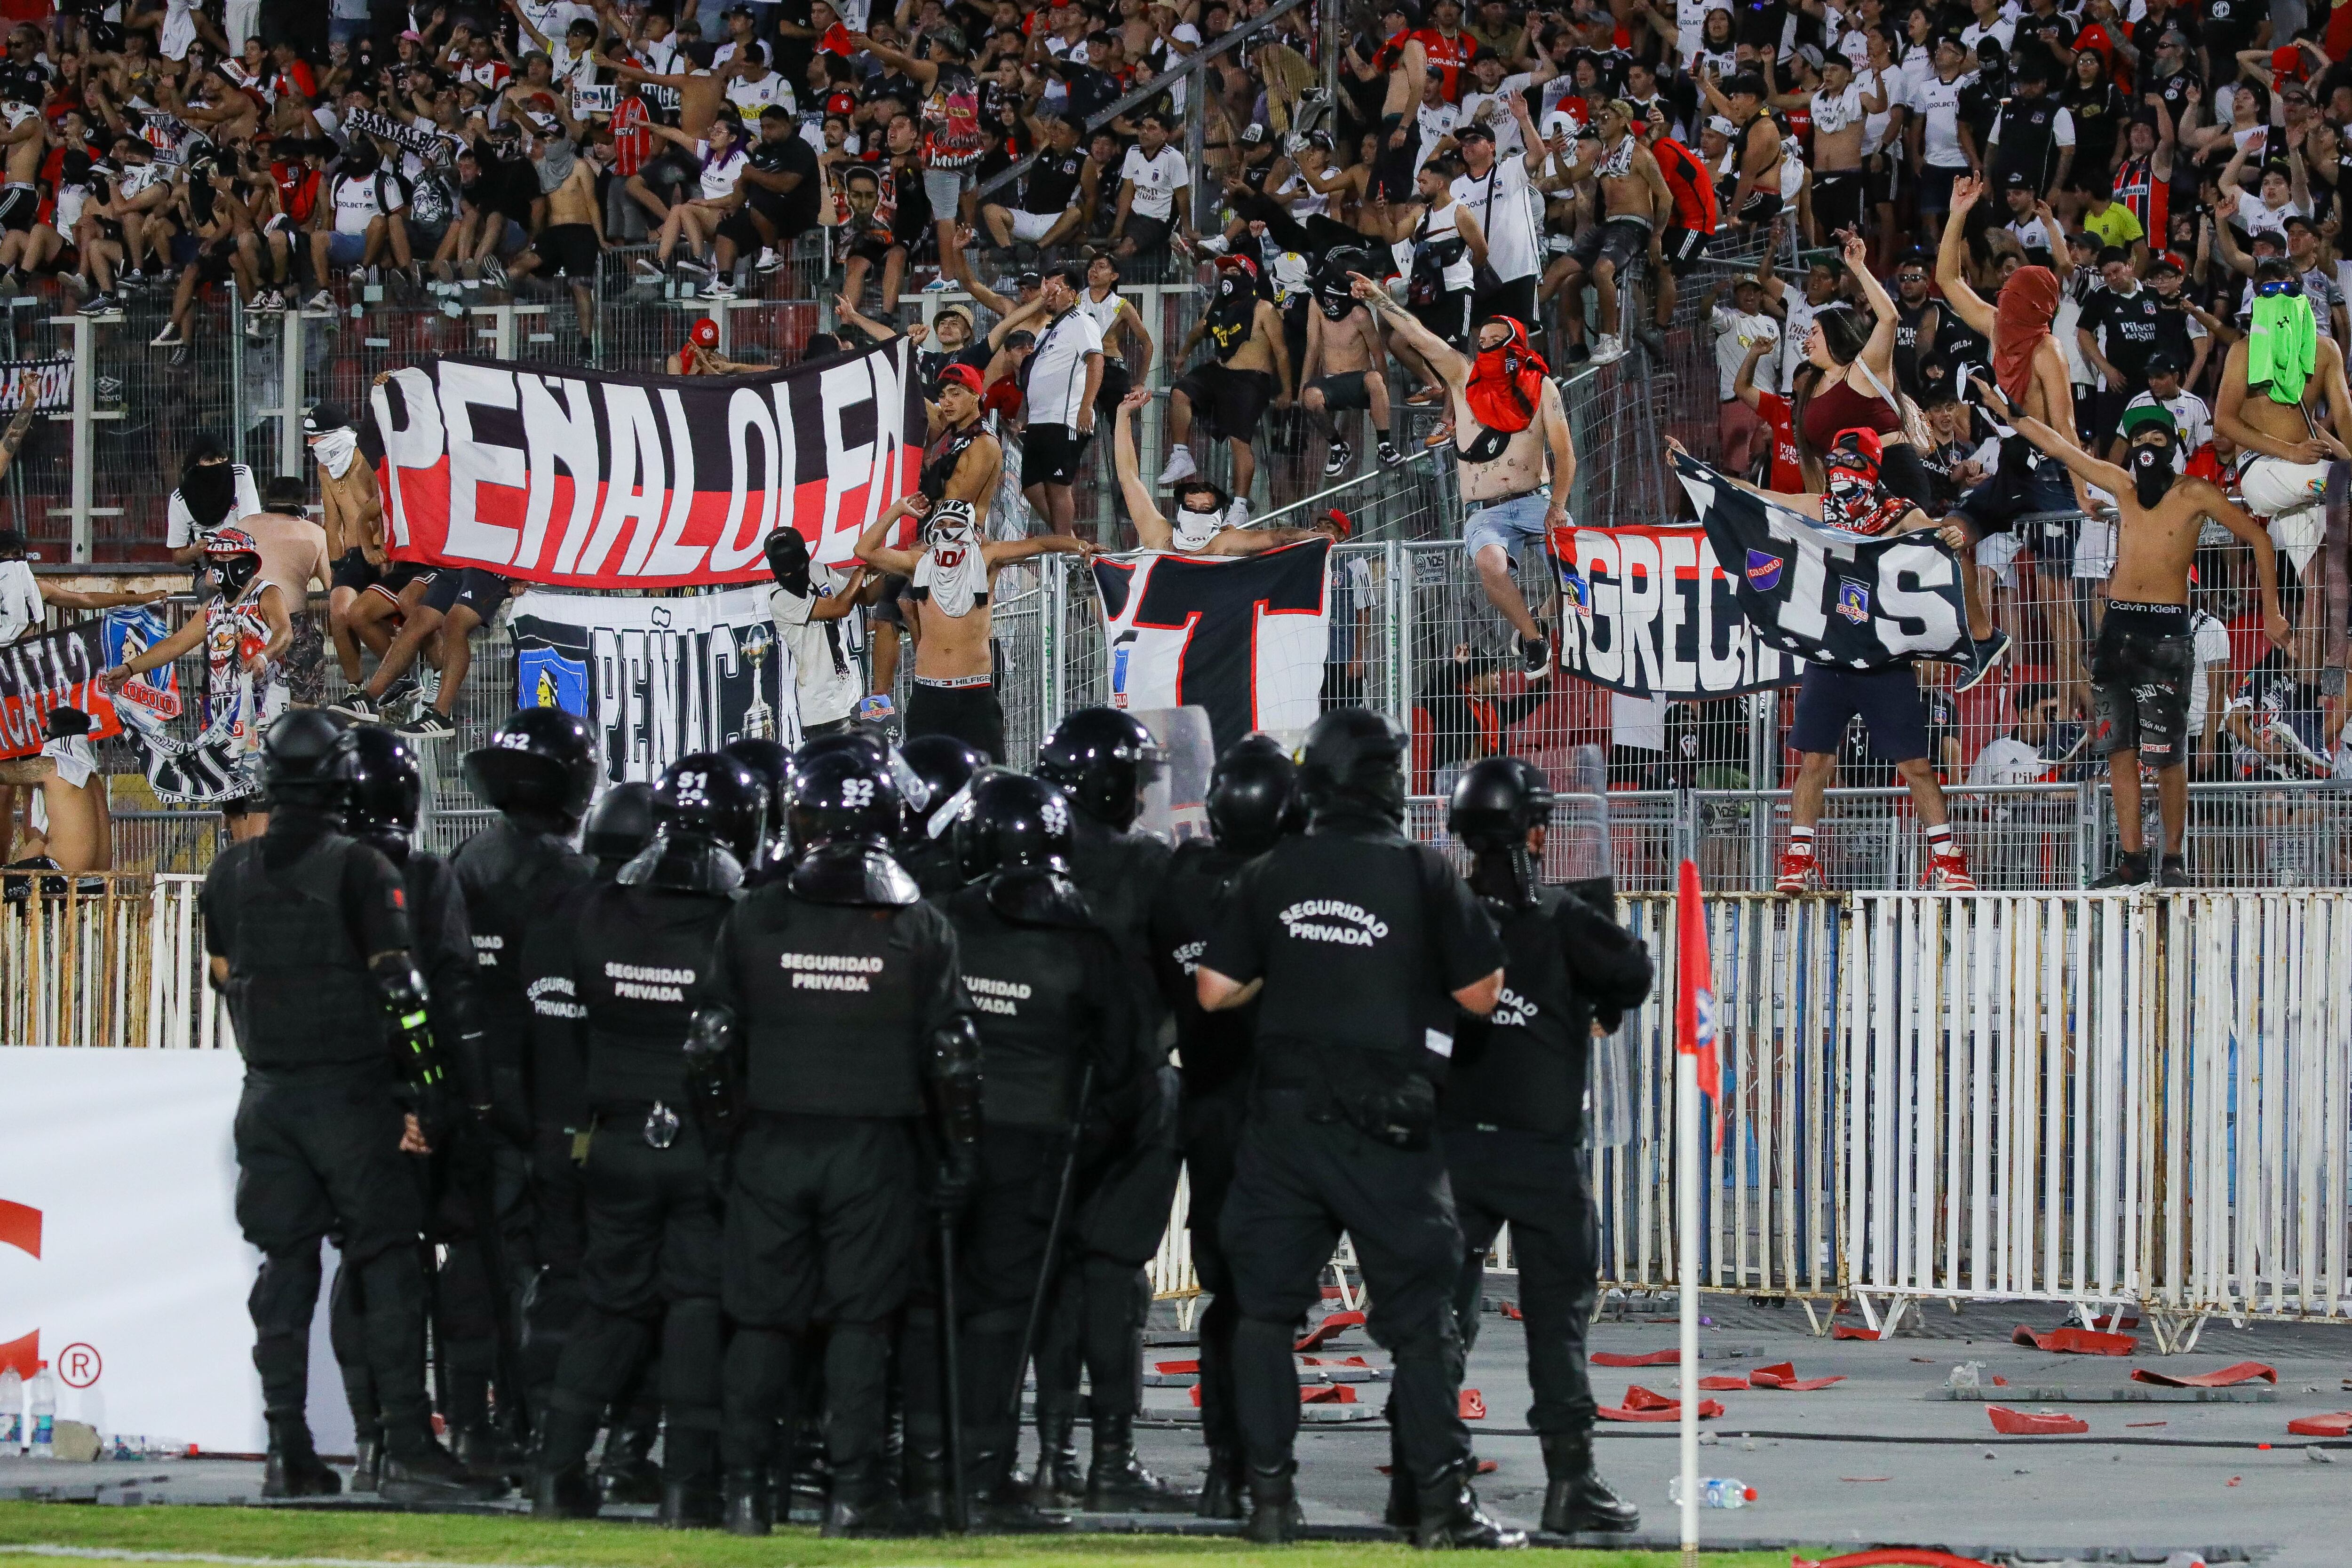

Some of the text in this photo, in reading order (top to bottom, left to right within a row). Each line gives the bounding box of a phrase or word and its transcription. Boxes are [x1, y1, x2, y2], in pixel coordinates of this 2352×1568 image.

[1428, 57, 1457, 67] COOLBET
[2120, 322, 2155, 333] Pilsen
[1749, 560, 1780, 577] COLO COLO
[2110, 601, 2181, 614] Calvin Klein
[141, 688, 174, 713] COLO
[501, 733, 531, 751] S2
[677, 771, 708, 789] S1
[842, 778, 875, 797] S2
[1041, 804, 1068, 826] S2
[1279, 899, 1389, 939] SEGURIDAD
[1289, 922, 1374, 947] PRIVADA
[605, 961, 696, 985] SEGURIDAD
[780, 953, 884, 973] SEGURIDAD
[615, 982, 684, 1002] PRIVADA
[792, 972, 870, 992] PRIVADA
